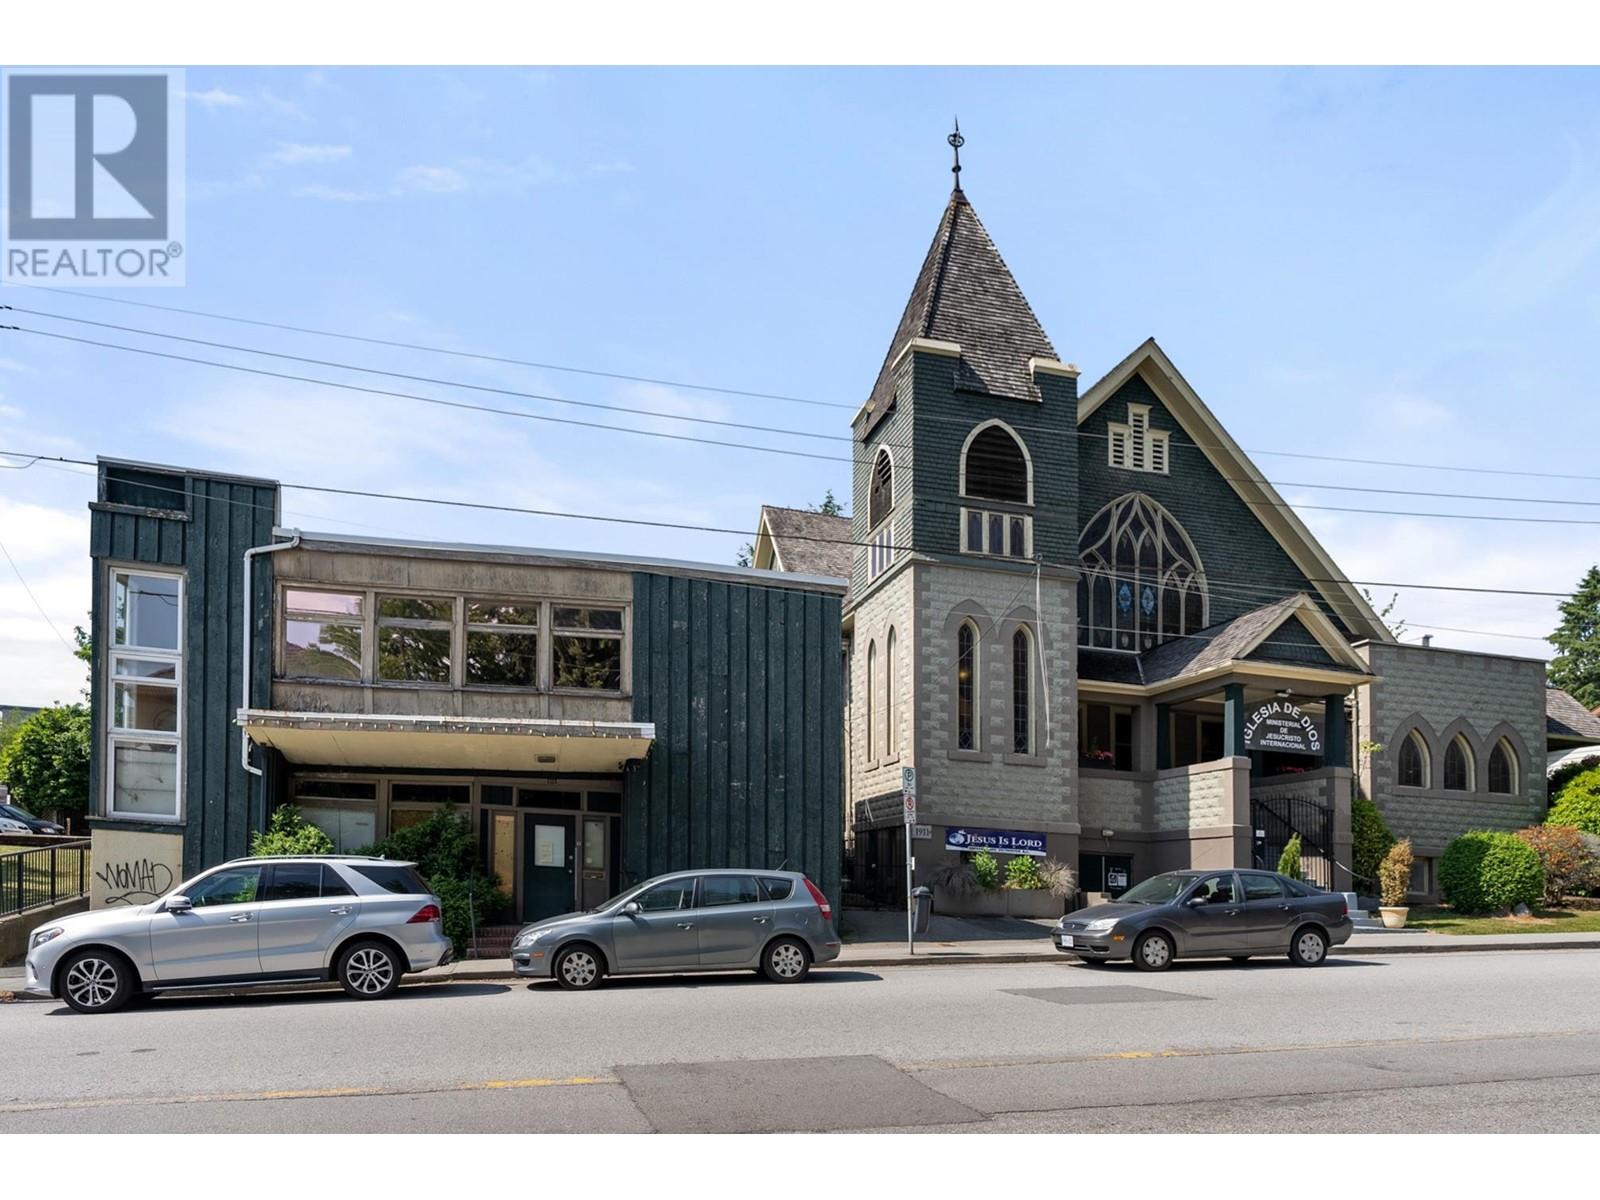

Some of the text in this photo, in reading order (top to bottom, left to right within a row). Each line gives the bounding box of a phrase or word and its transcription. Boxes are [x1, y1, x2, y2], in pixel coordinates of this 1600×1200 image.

[1244, 702, 1320, 751] IGLESIA DE DIOS
[1266, 719, 1302, 728] MINISTERIAL
[1265, 733, 1302, 742] JESUCRISTO
[1260, 739, 1306, 750] INTERNACIONAL
[965, 834, 996, 845] JESUS
[1011, 837, 1042, 847] LORD
